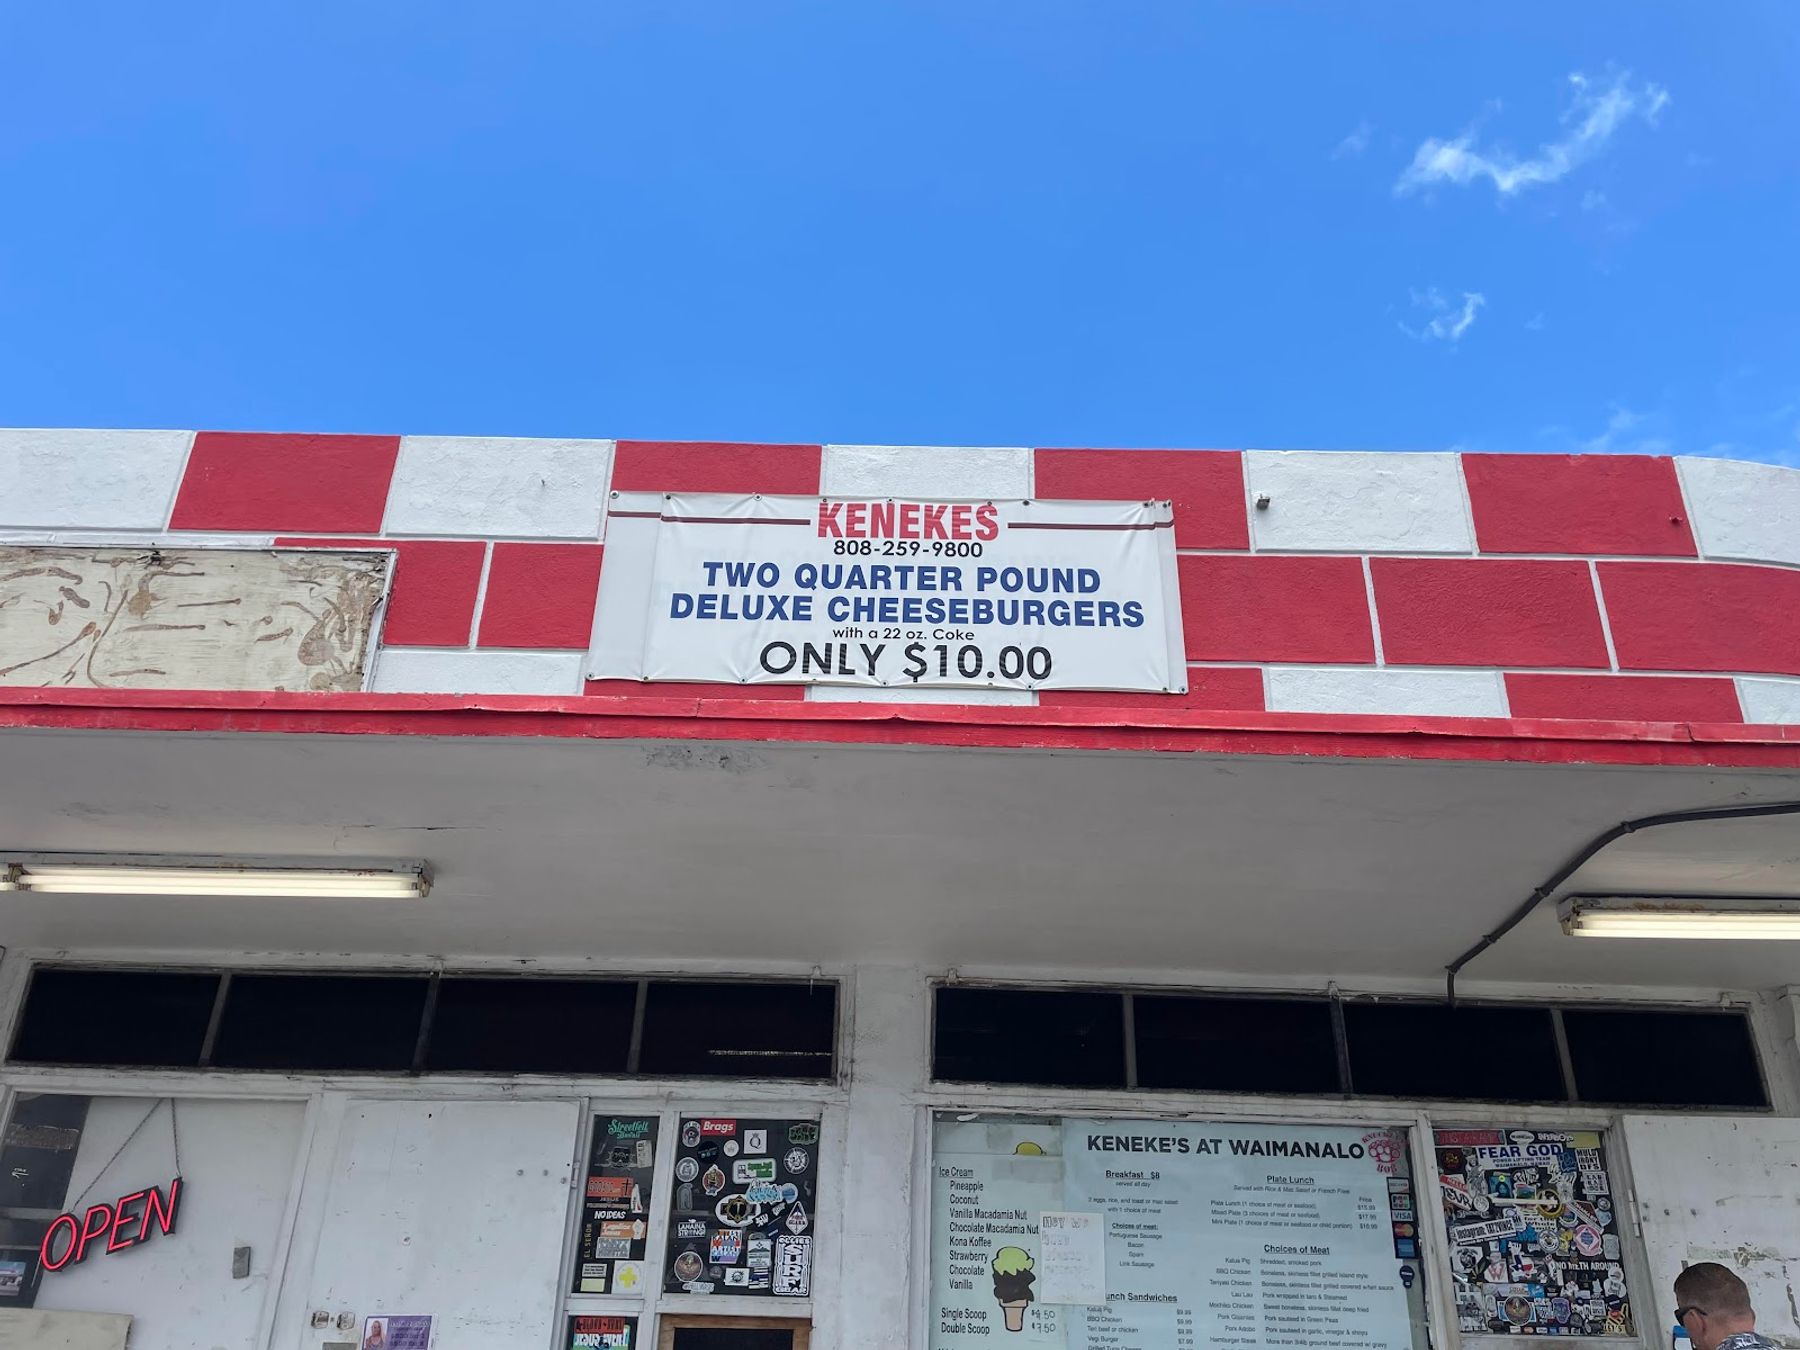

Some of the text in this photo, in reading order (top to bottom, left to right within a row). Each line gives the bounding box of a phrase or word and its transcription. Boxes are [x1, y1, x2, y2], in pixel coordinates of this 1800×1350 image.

[818, 502, 998, 541] KENEKES
[834, 540, 983, 558] 808-259-9800
[703, 562, 1101, 593] TWO QUARTER POUND
[670, 593, 1145, 627] DELUXE CHEESEBURGERS
[832, 627, 975, 641] with a 22 oz. Coke
[760, 641, 1052, 683] ONLY $10.00
[703, 1122, 733, 1133] Brags
[1087, 1135, 1364, 1159] KENEKE'S AT WAIMANALO
[1479, 1146, 1521, 1158] FEAR
[1526, 1144, 1562, 1157] GOD
[939, 1166, 974, 1178] Ice Cream
[1105, 1170, 1144, 1179] Breakfast
[950, 1180, 984, 1193] Pineapple
[1266, 1175, 1315, 1185] Plate Lunch
[950, 1193, 979, 1205] Coconut
[594, 1211, 627, 1220] NO IDEAS
[949, 1207, 1028, 1221] Vanilla Macadamia Nut
[1394, 1211, 1412, 1220] VISA
[41, 1178, 182, 1271] OPEN
[949, 1221, 1039, 1235] Chocolate Macadamia Nut
[949, 1236, 992, 1248] Kona Koffee
[1264, 1244, 1330, 1255] Choices of Meat
[949, 1250, 988, 1264] Strawberry
[949, 1264, 985, 1276] Chocolate
[949, 1279, 973, 1290] Vanilla
[1105, 1292, 1178, 1303] unch Sandwiches
[941, 1307, 987, 1321] Single Scoop
[941, 1322, 990, 1336] Double Scoop
